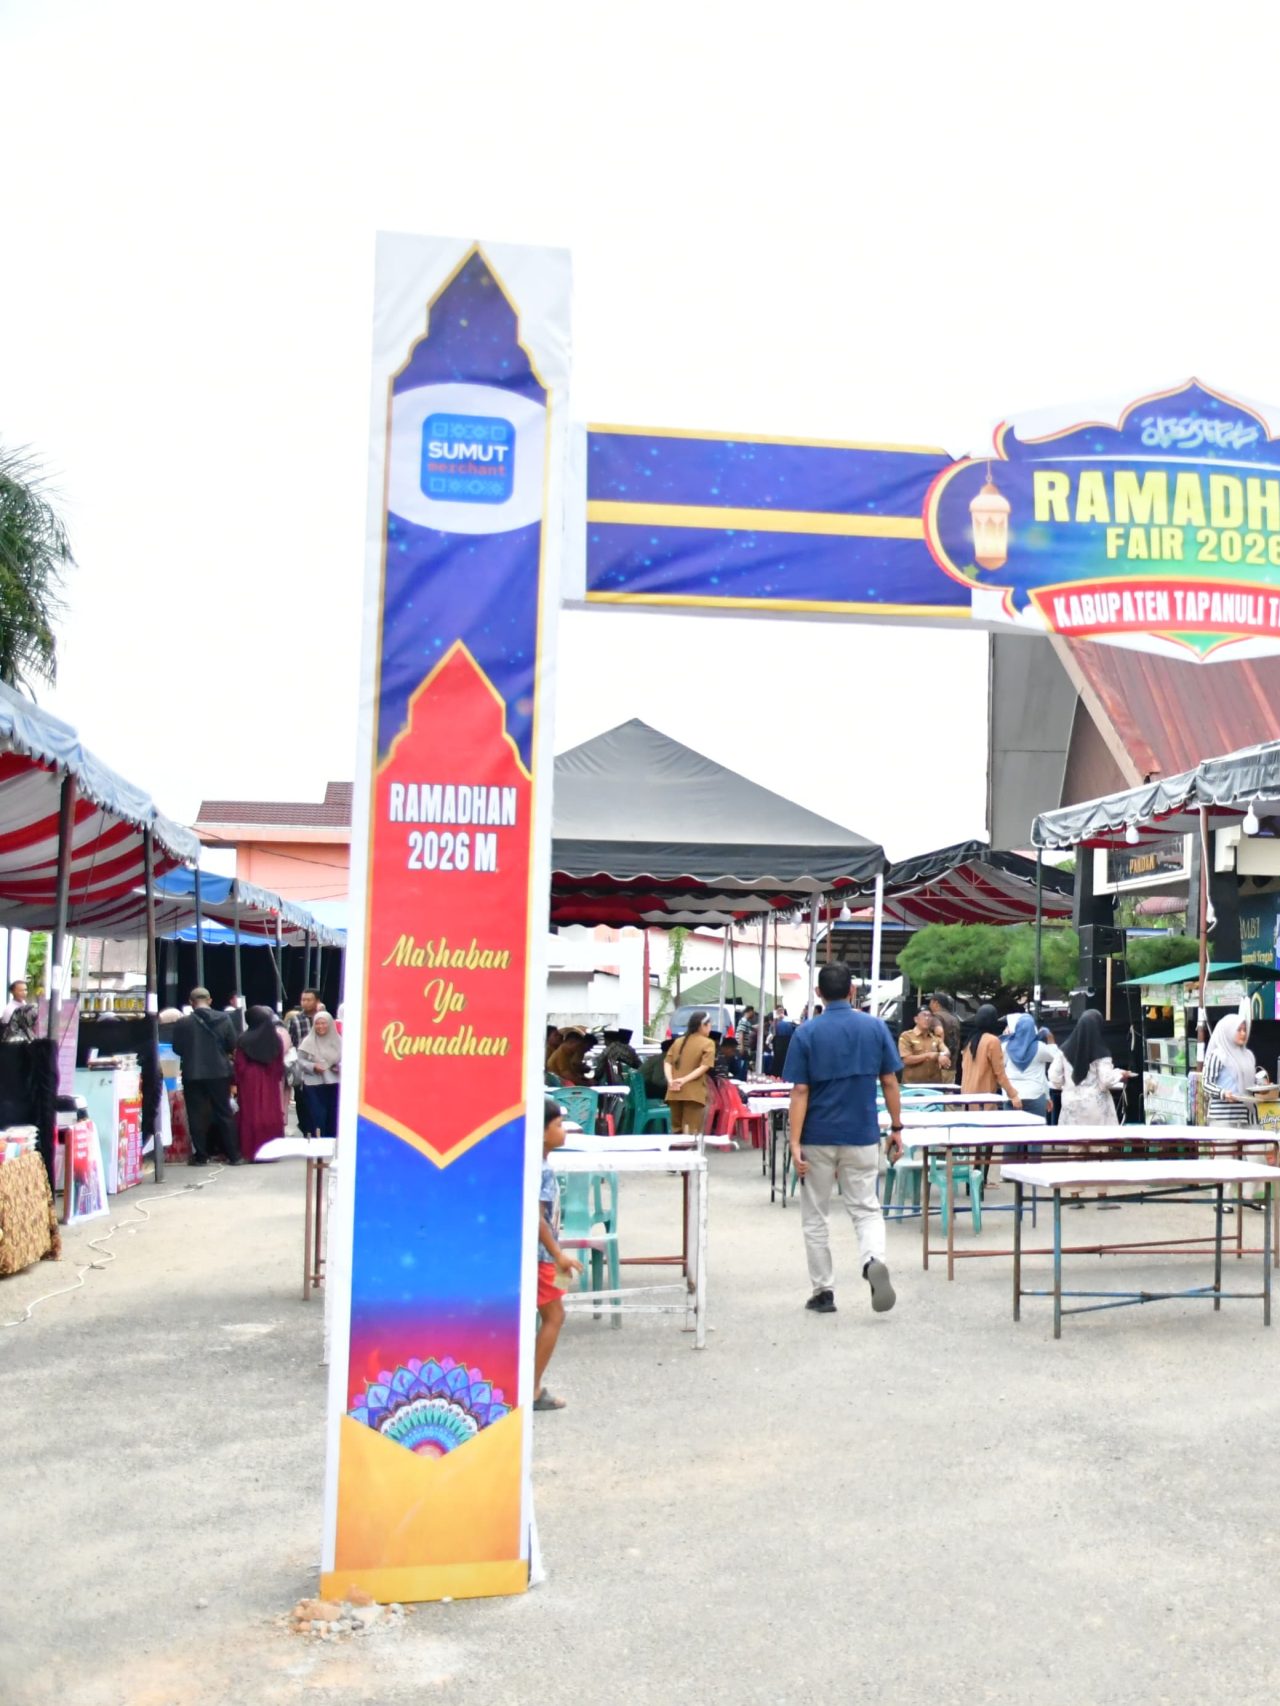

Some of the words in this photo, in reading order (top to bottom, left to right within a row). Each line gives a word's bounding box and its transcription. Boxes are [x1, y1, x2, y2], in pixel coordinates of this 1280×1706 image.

[428, 441, 509, 462] SUMUT
[1106, 527, 1184, 561] FAIR
[1053, 590, 1171, 628] KABUPATEN
[1173, 590, 1264, 625] TAPANULI
[389, 782, 517, 826] RAMADHAN
[407, 830, 470, 872] 2026
[473, 832, 496, 872] M
[381, 933, 511, 970] Marhaban
[424, 978, 466, 1024] Ya
[381, 1020, 510, 1061] Ramadhan
